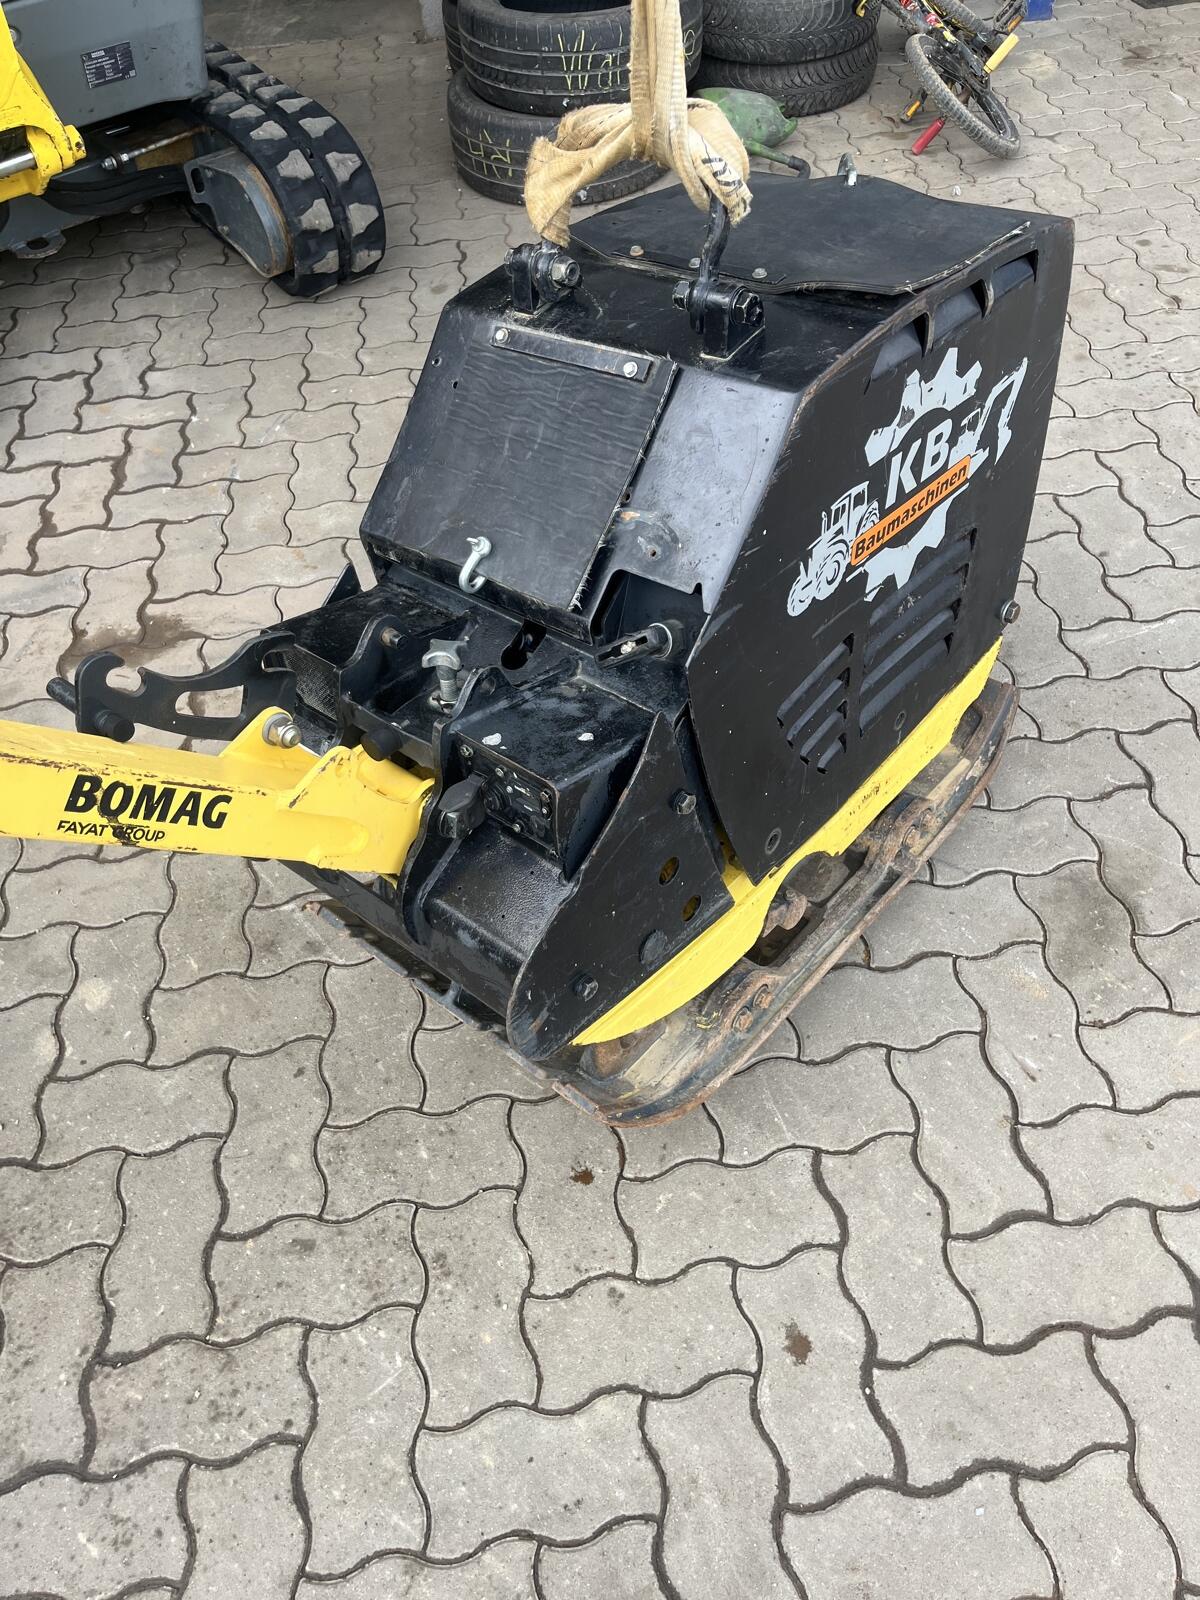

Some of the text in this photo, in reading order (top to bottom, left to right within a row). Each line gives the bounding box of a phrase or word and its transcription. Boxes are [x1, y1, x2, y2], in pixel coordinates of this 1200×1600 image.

[884, 418, 953, 510] KB
[853, 465, 967, 561] Baumaschinen
[57, 820, 109, 837] FAYAT
[63, 773, 233, 831] BOMAG
